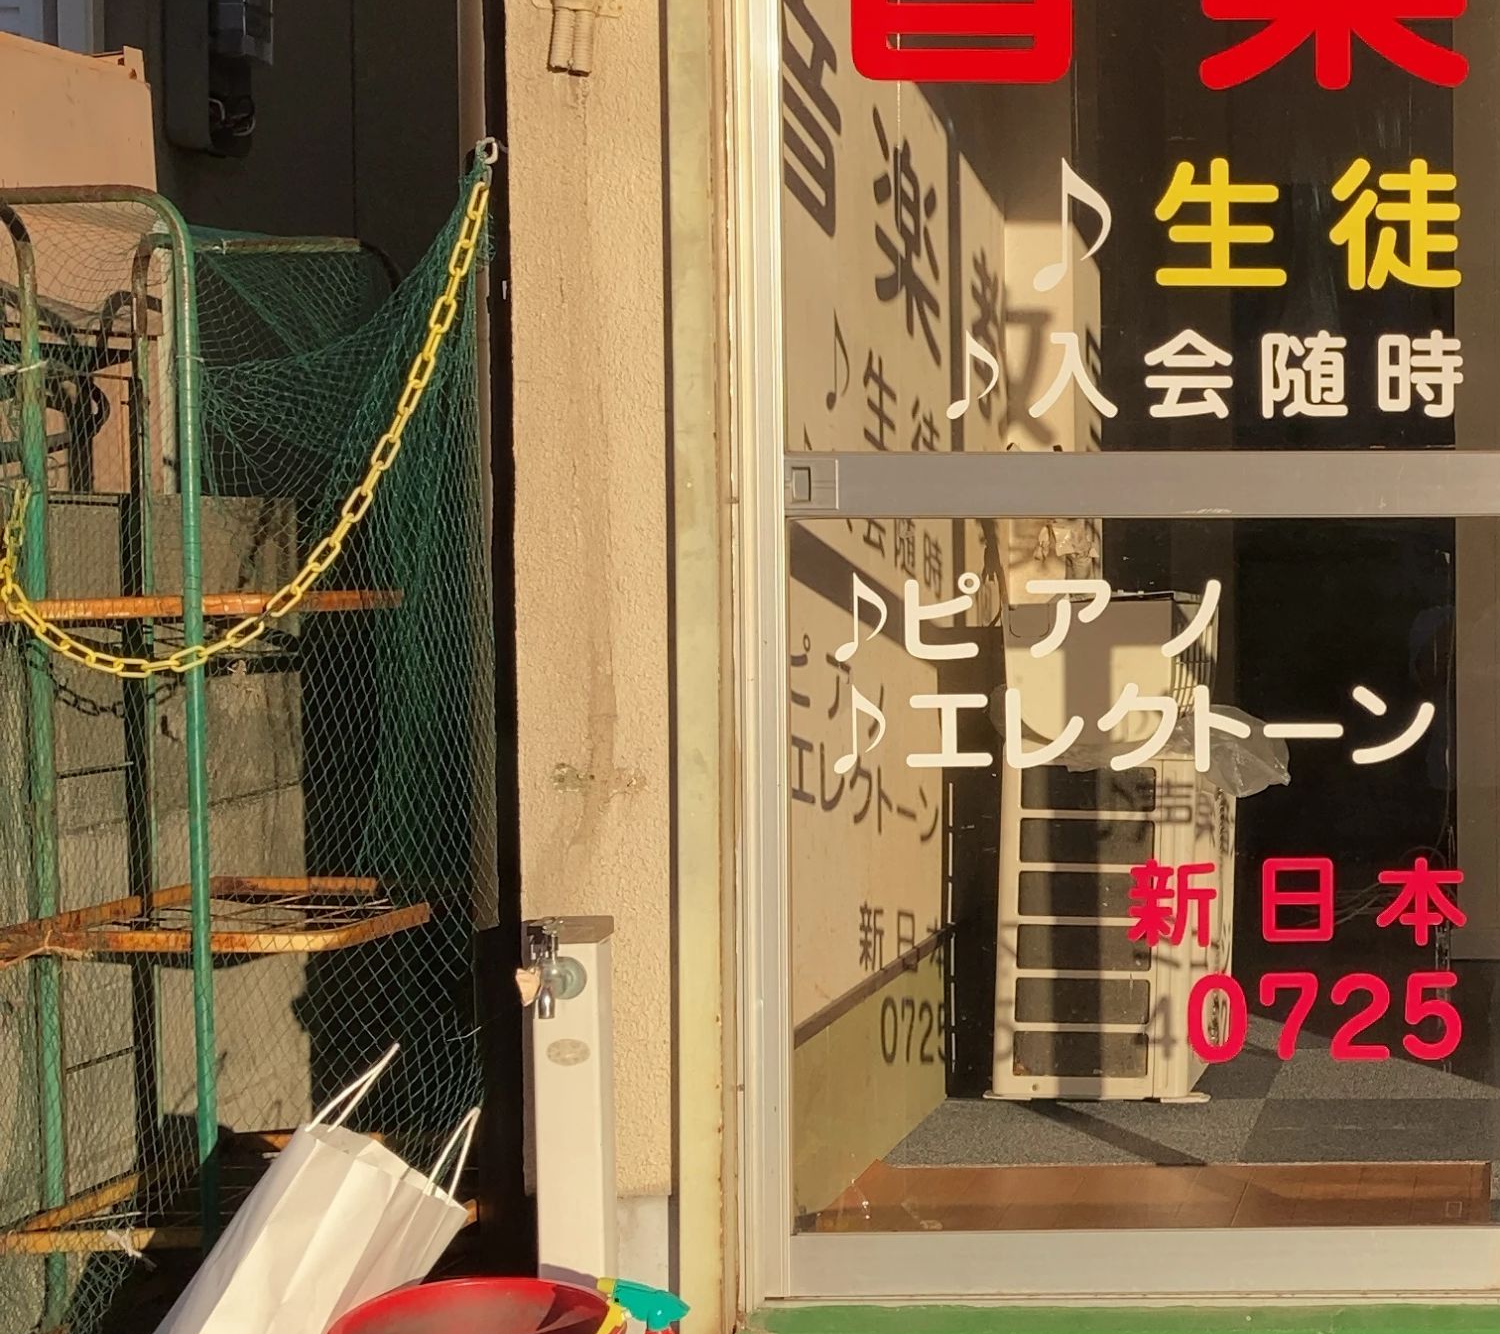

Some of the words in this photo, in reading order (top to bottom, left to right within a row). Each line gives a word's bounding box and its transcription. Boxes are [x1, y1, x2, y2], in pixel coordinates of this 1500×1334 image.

[1028, 328, 1464, 419] 入会随時
[903, 572, 1222, 659] ピアノ
[905, 682, 1436, 773] エレクトーン
[1187, 971, 1463, 1063] 0725
